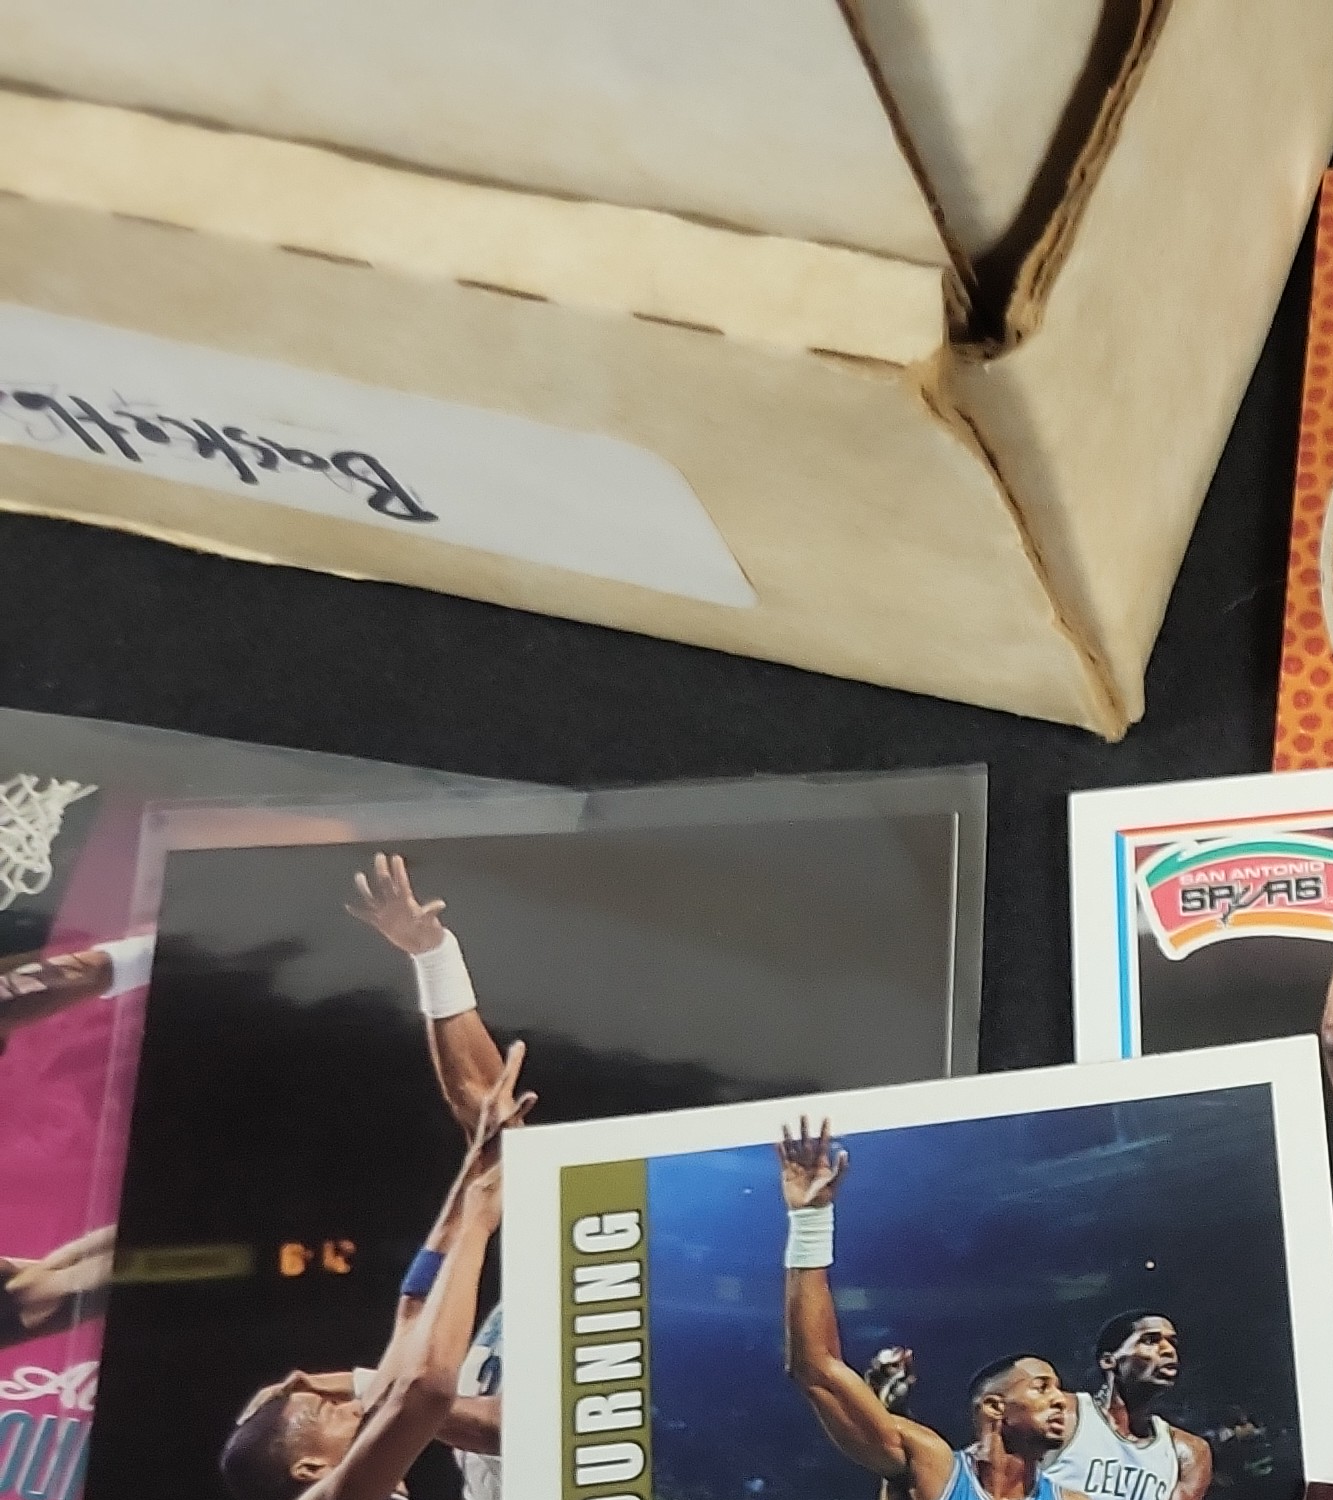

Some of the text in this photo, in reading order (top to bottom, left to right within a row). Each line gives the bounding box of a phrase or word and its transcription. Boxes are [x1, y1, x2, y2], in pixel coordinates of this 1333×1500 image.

[0, 389, 438, 522] Basketb
[1180, 861, 1325, 886] SAN ANTONIO
